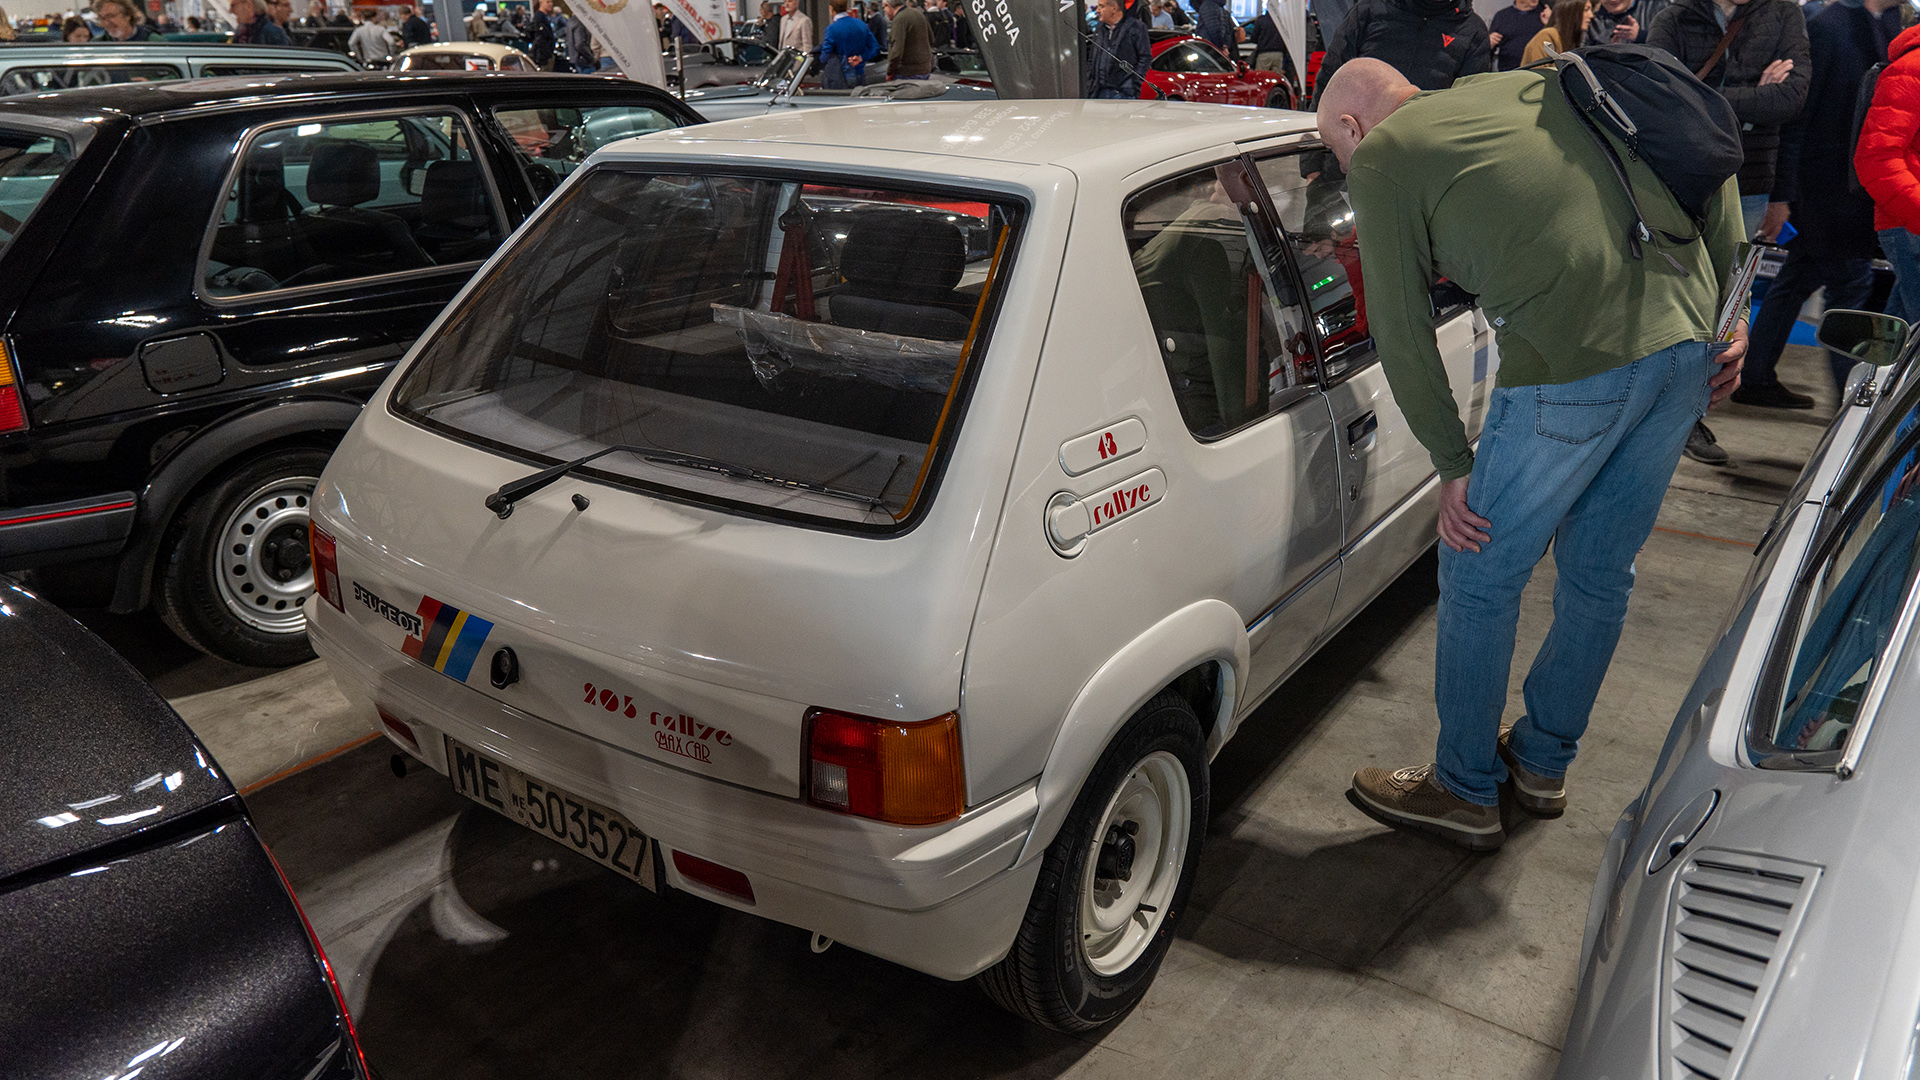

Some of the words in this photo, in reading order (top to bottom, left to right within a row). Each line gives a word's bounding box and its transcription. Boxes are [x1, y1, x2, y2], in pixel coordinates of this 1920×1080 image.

[1093, 484, 1151, 525] rallye
[353, 582, 423, 637] PEUGEOT
[583, 682, 637, 719] 205
[650, 711, 733, 747] rallye
[654, 730, 684, 754] MAX
[685, 740, 712, 765] CAR
[455, 746, 504, 809] ME
[526, 780, 648, 878] 503527
